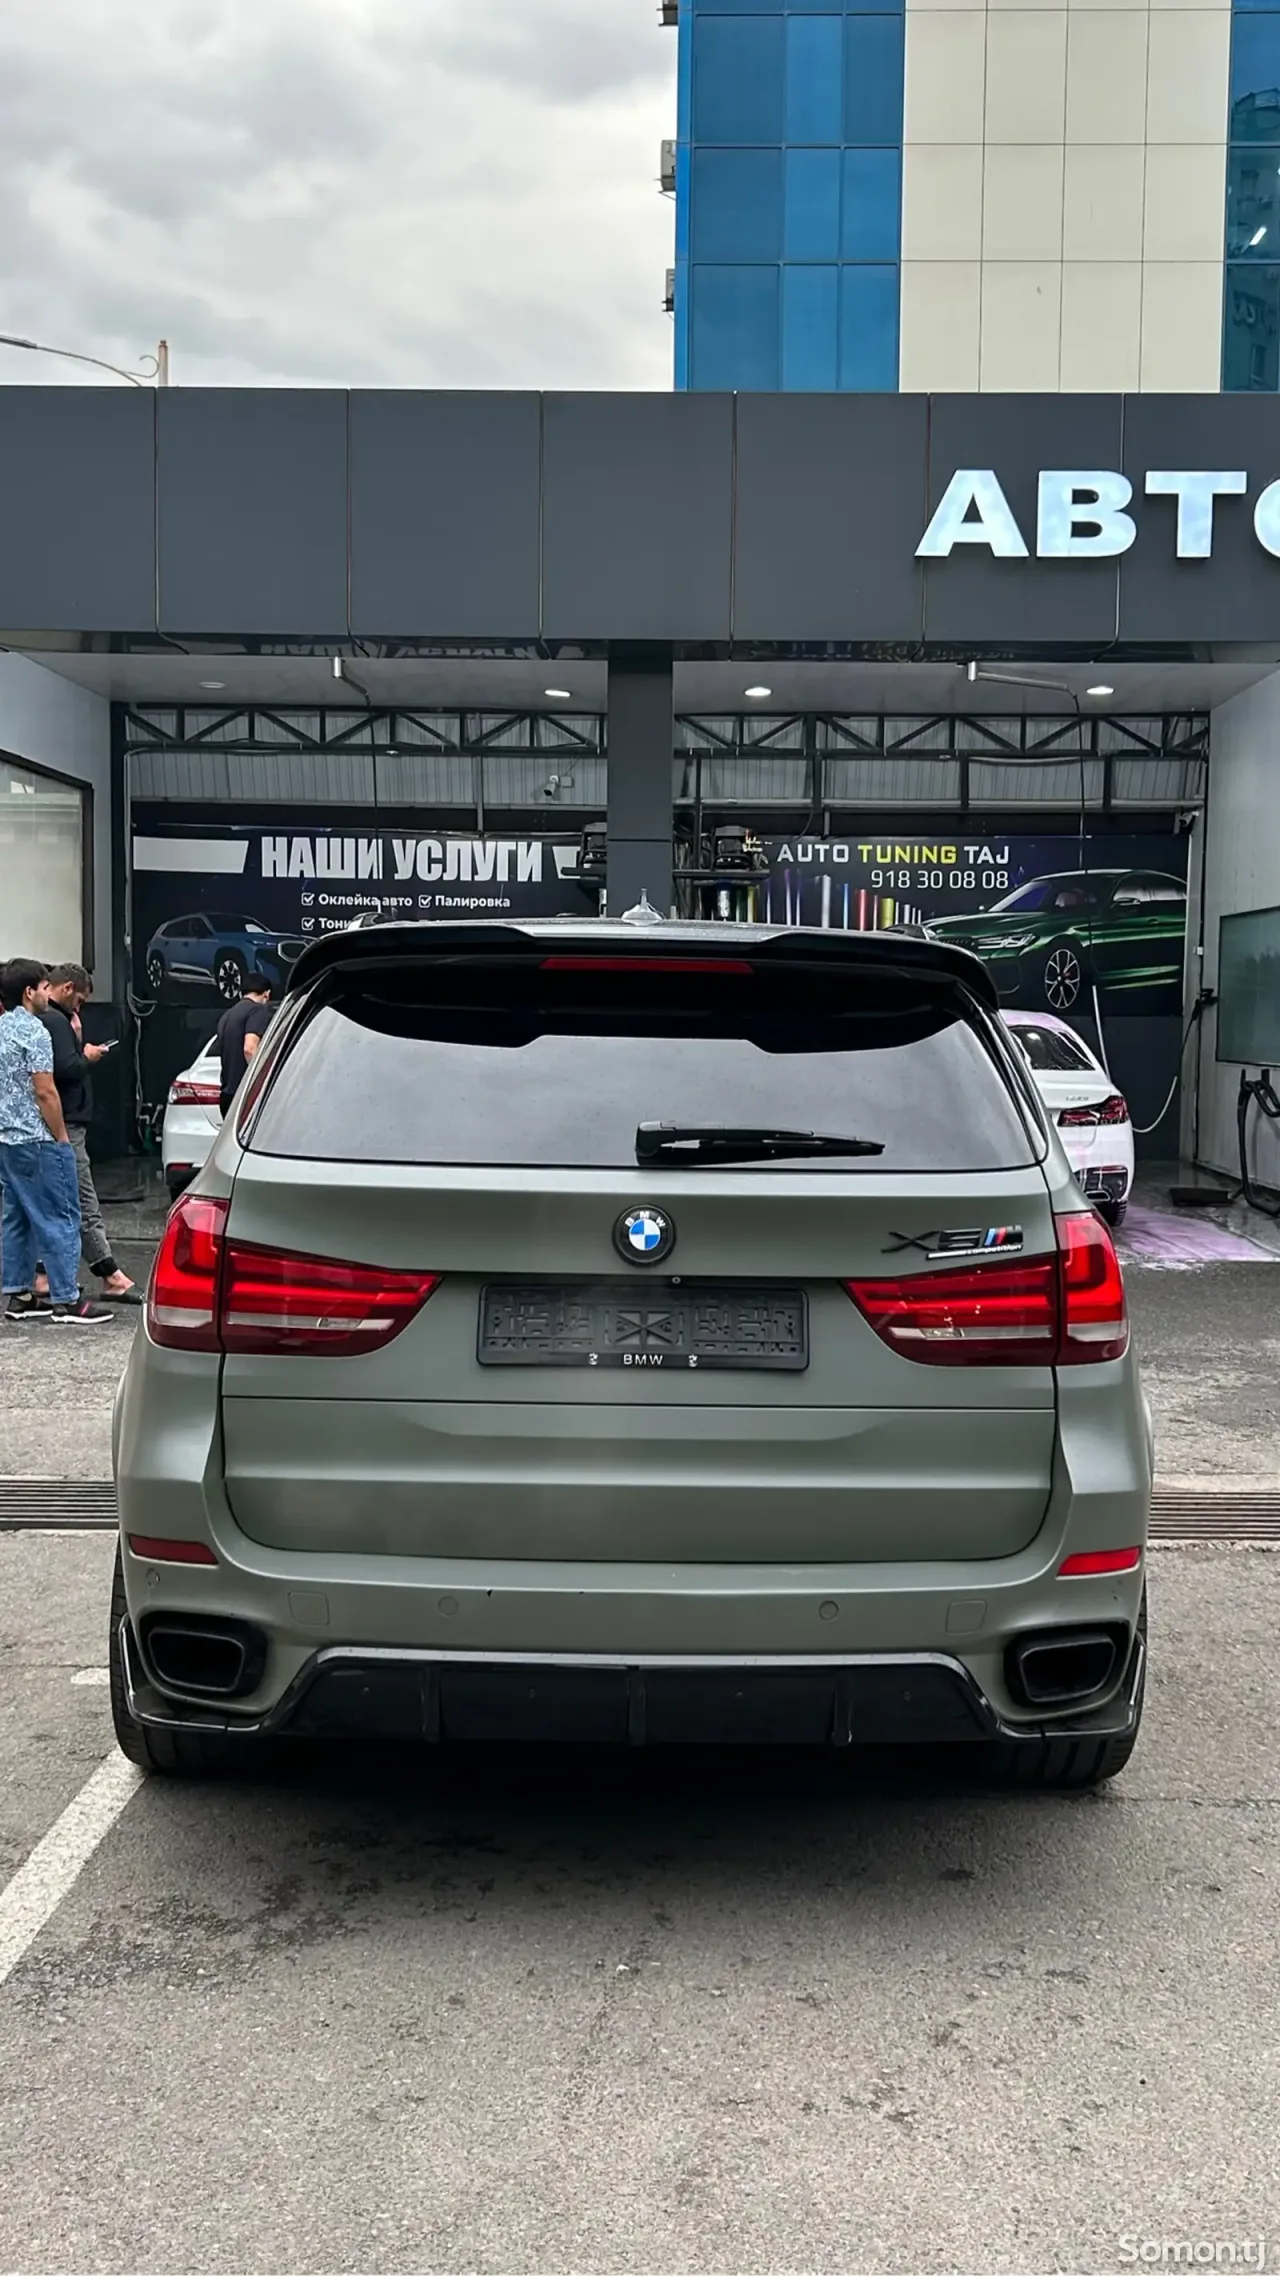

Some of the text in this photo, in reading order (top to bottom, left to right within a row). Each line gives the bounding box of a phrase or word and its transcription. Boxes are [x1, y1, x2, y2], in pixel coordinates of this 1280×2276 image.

[914, 469, 1280, 558] АВТ
[261, 836, 543, 883] НАШИ УСЛУГИ
[777, 843, 1010, 865] AUTO TUNING TAJ
[871, 869, 1009, 890] 918 30 08 08
[318, 893, 413, 908] Оклейка авто
[435, 895, 511, 909] Палировка
[624, 1210, 666, 1228] BMW
[623, 1354, 664, 1366] BMW
